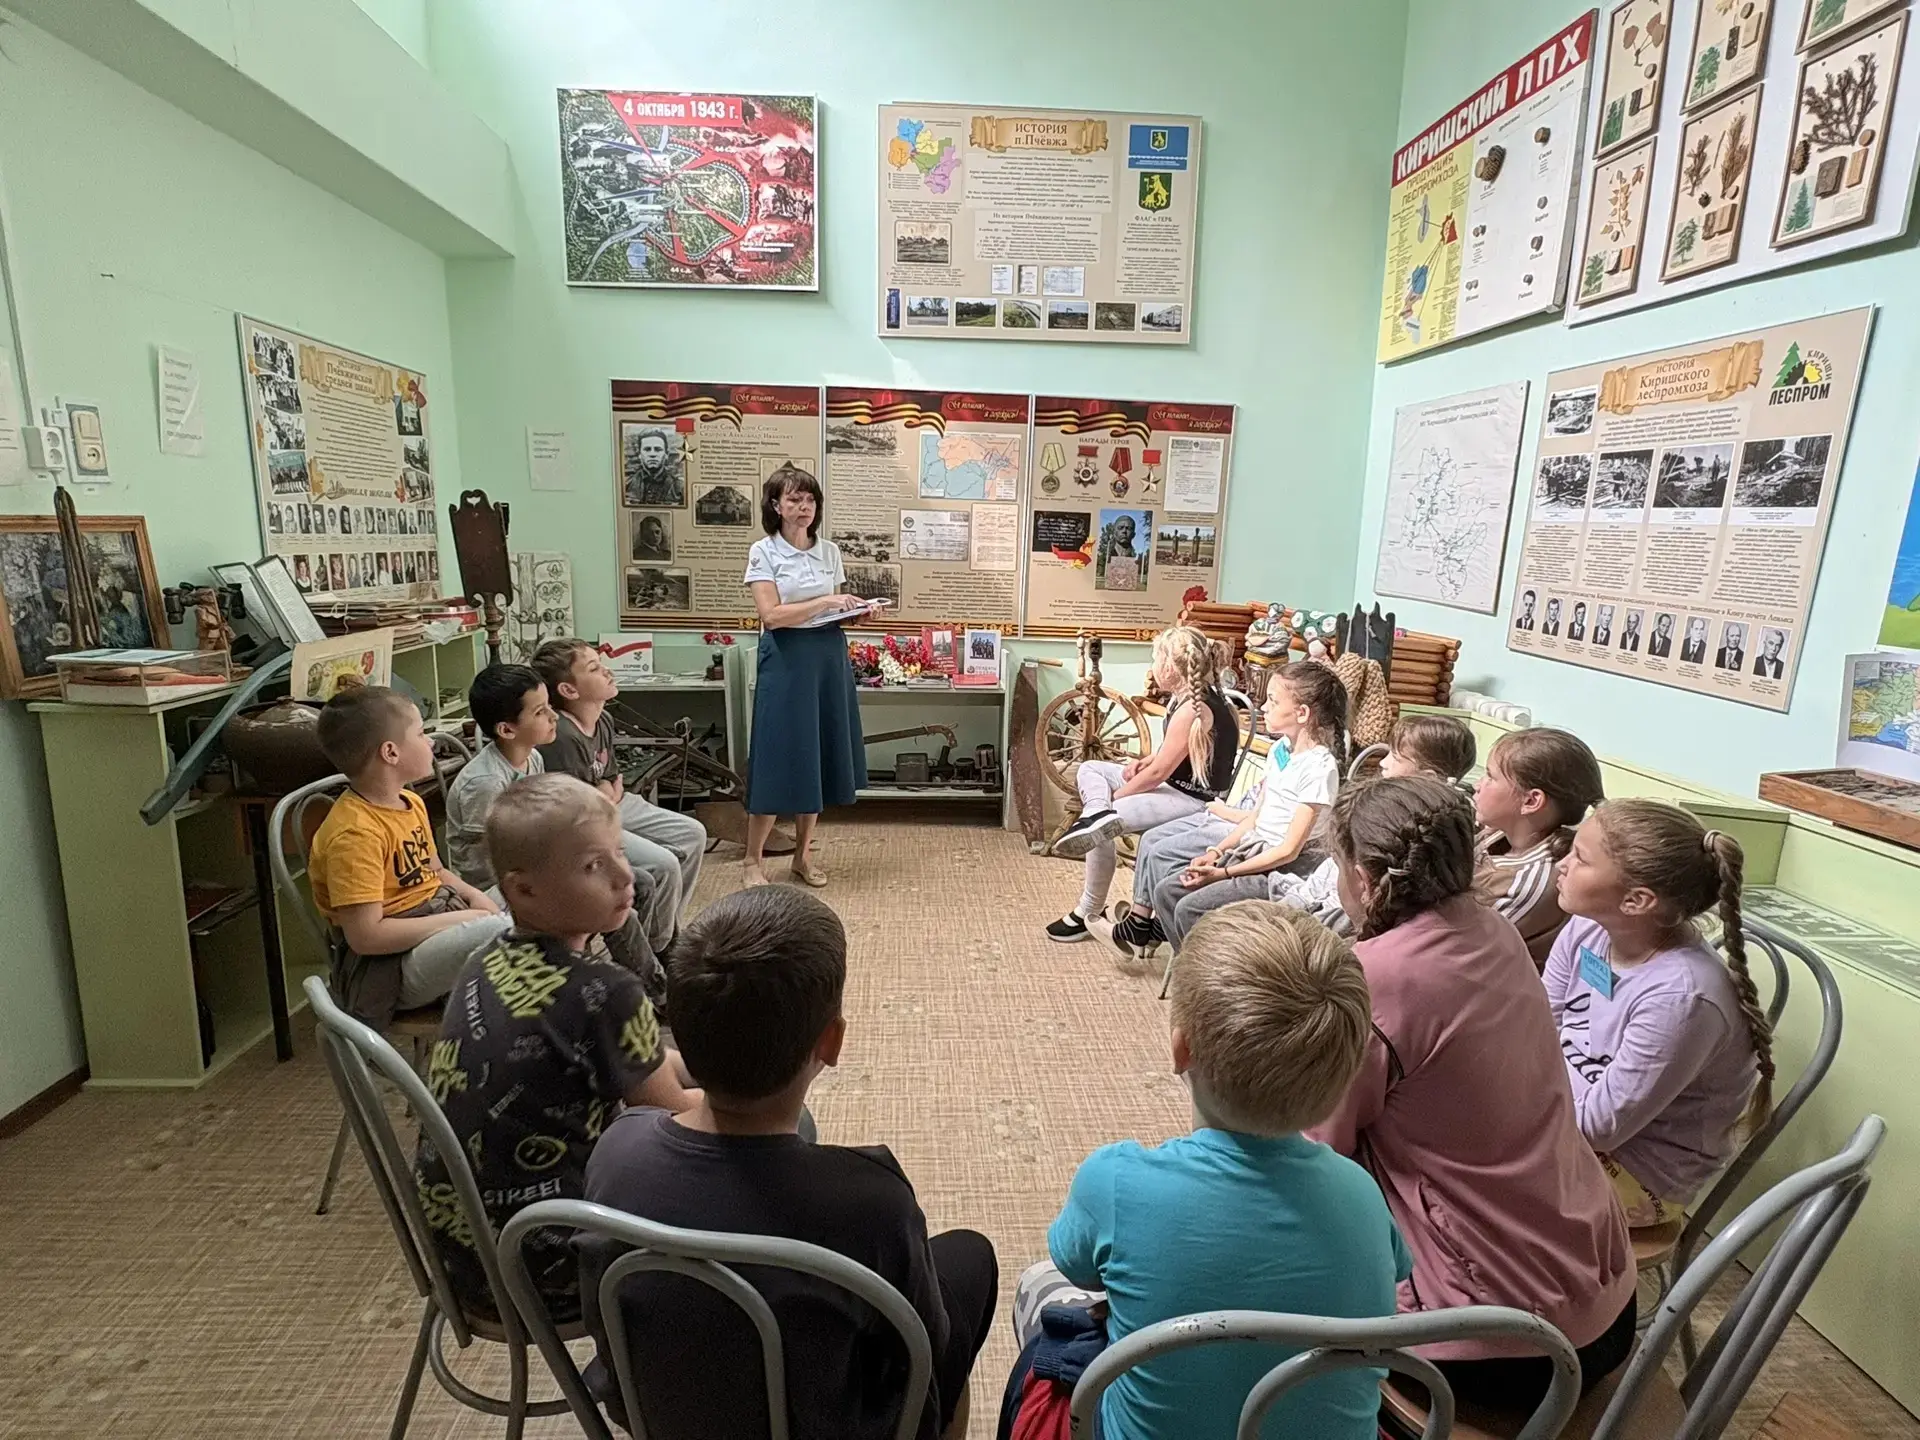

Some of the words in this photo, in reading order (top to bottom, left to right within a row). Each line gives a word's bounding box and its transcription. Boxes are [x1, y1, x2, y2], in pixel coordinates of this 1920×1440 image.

[624, 98, 633, 116] 4
[637, 102, 685, 114] ОКТЯБРЯ
[690, 101, 725, 119] 1943
[1396, 74, 1508, 181] КИРИШСКИЙ
[1515, 25, 1584, 102] ЛПХ
[1015, 123, 1067, 135] ИСТОРИЯ
[1406, 153, 1454, 190] ПРОДУКЦИЯ
[1401, 164, 1459, 206] ЛЕСПРОМХОЗА
[1655, 358, 1696, 374] ИСТОРИЯ
[1807, 350, 1832, 381] КИРИШИ
[1636, 379, 1709, 400] леспромхоза
[1639, 366, 1711, 390] Киришского
[1768, 383, 1831, 406] ЛЕСПРОМ
[484, 1176, 564, 1206] STREET
